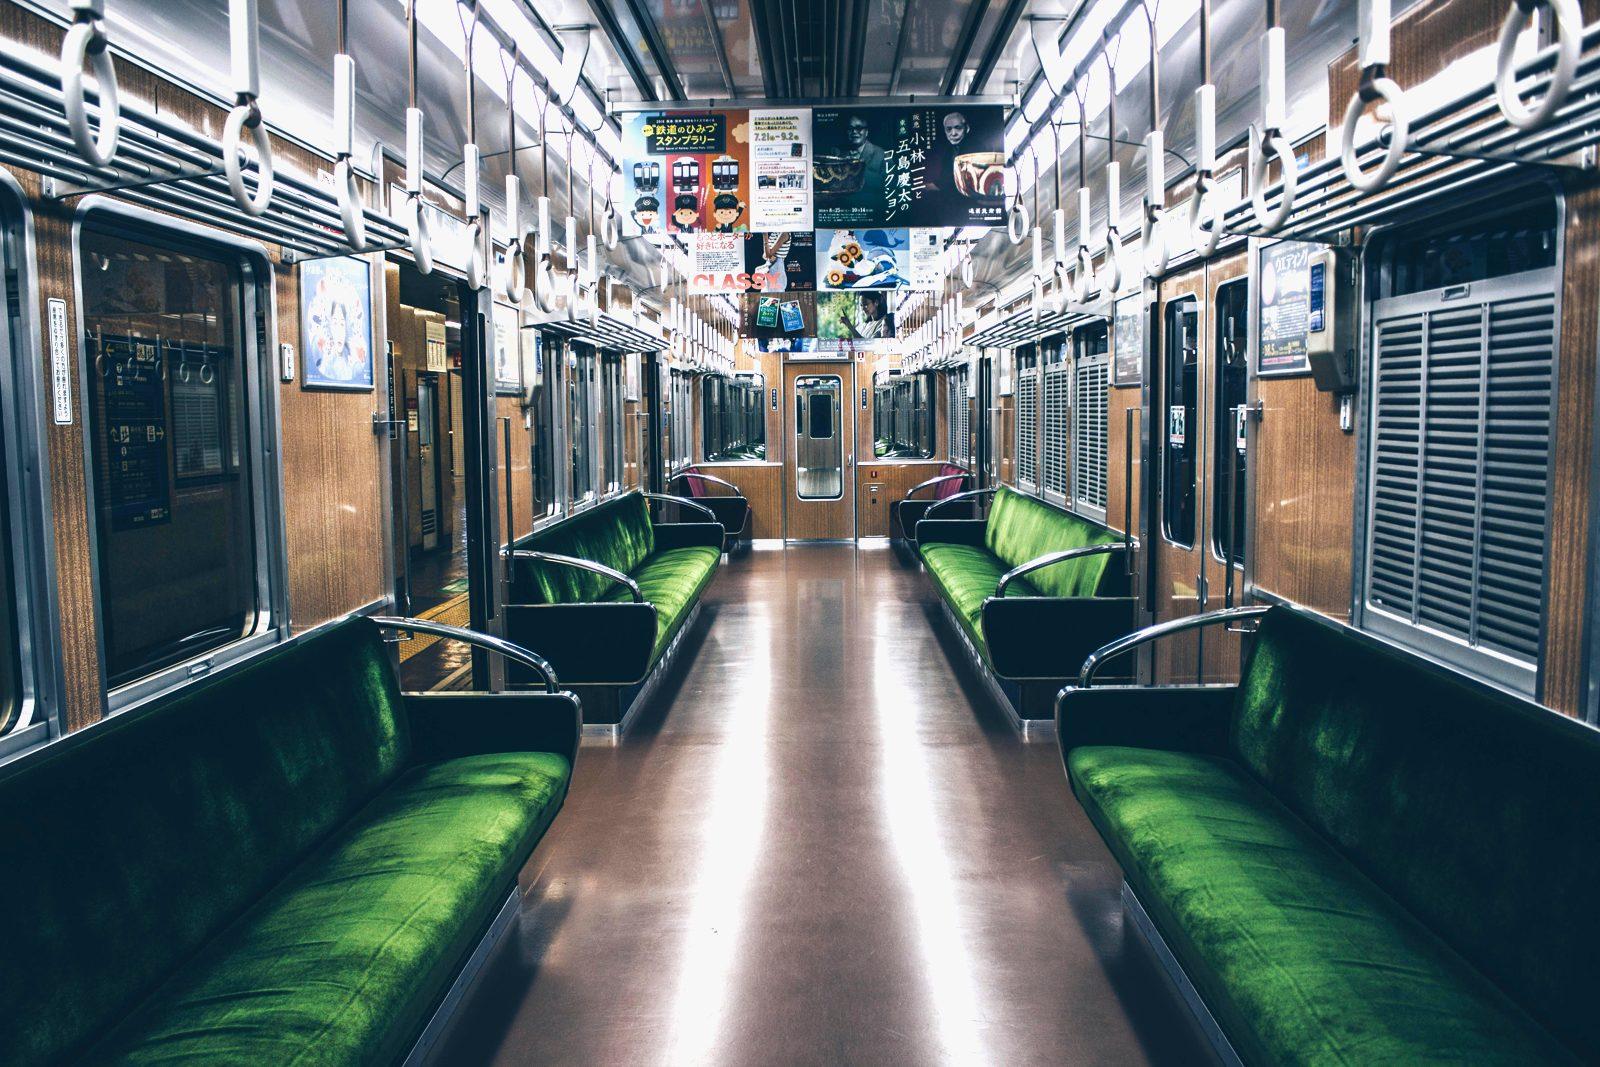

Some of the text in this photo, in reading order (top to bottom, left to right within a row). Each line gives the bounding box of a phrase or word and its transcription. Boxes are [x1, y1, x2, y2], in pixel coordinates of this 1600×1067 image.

[655, 134, 716, 146] スタンプラリー
[883, 149, 897, 221] コレクション
[696, 241, 735, 250] 好きになる
